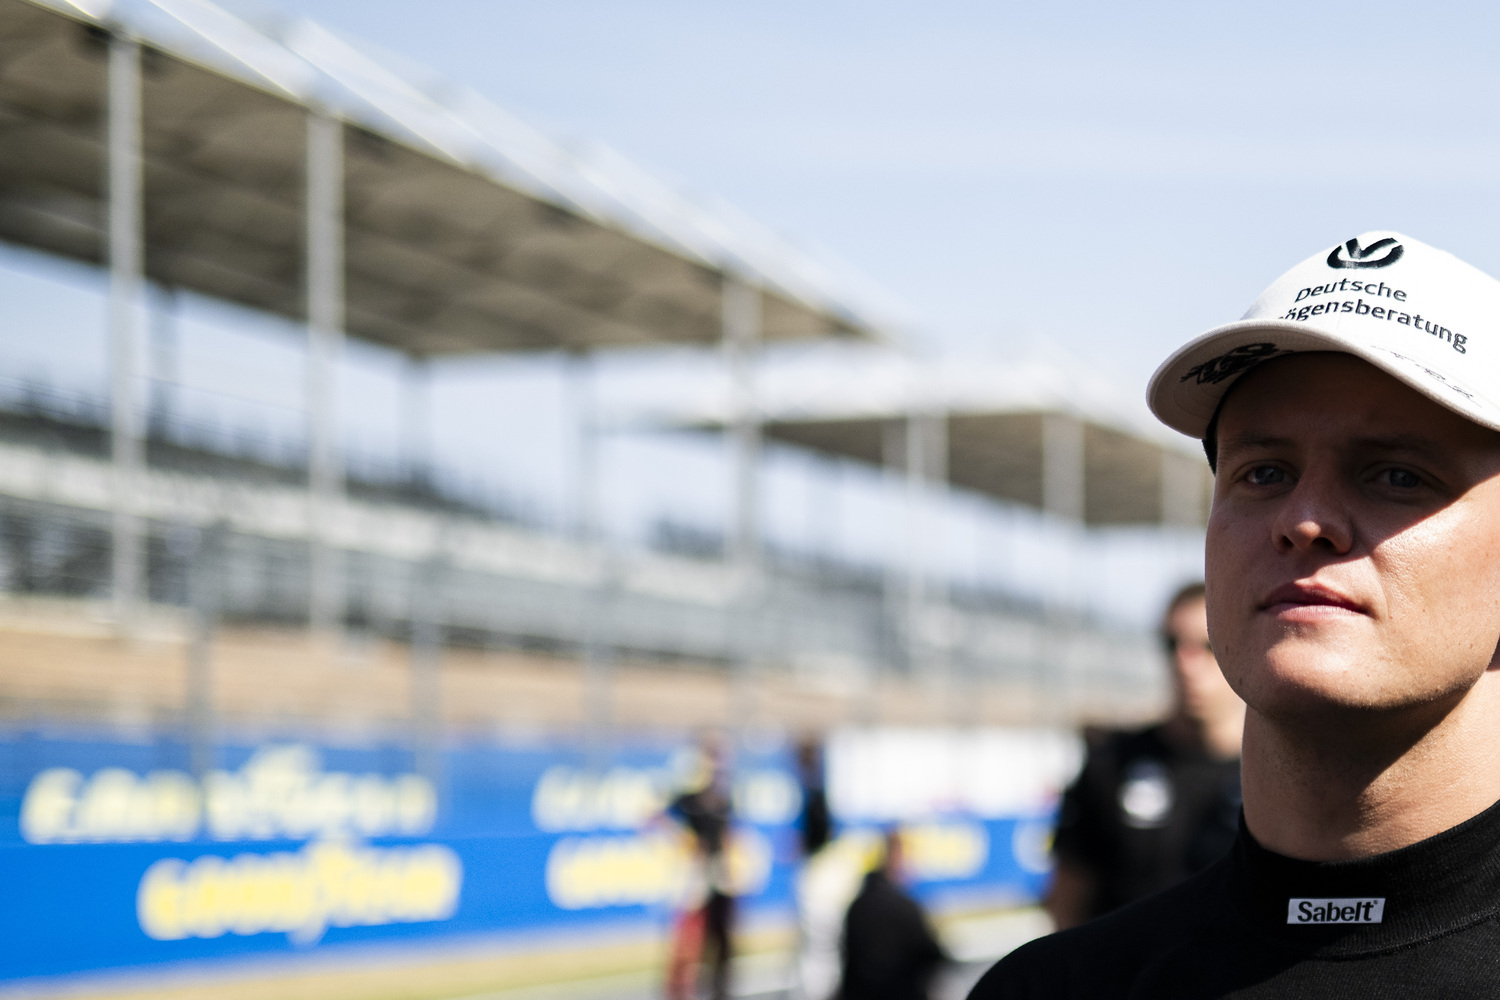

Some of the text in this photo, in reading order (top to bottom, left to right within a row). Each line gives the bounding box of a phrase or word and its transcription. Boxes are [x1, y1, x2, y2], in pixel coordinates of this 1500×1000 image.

[1295, 278, 1408, 303] Deutsche
[1278, 299, 1469, 355] ögensberatung
[1297, 901, 1375, 922] Sabelt
